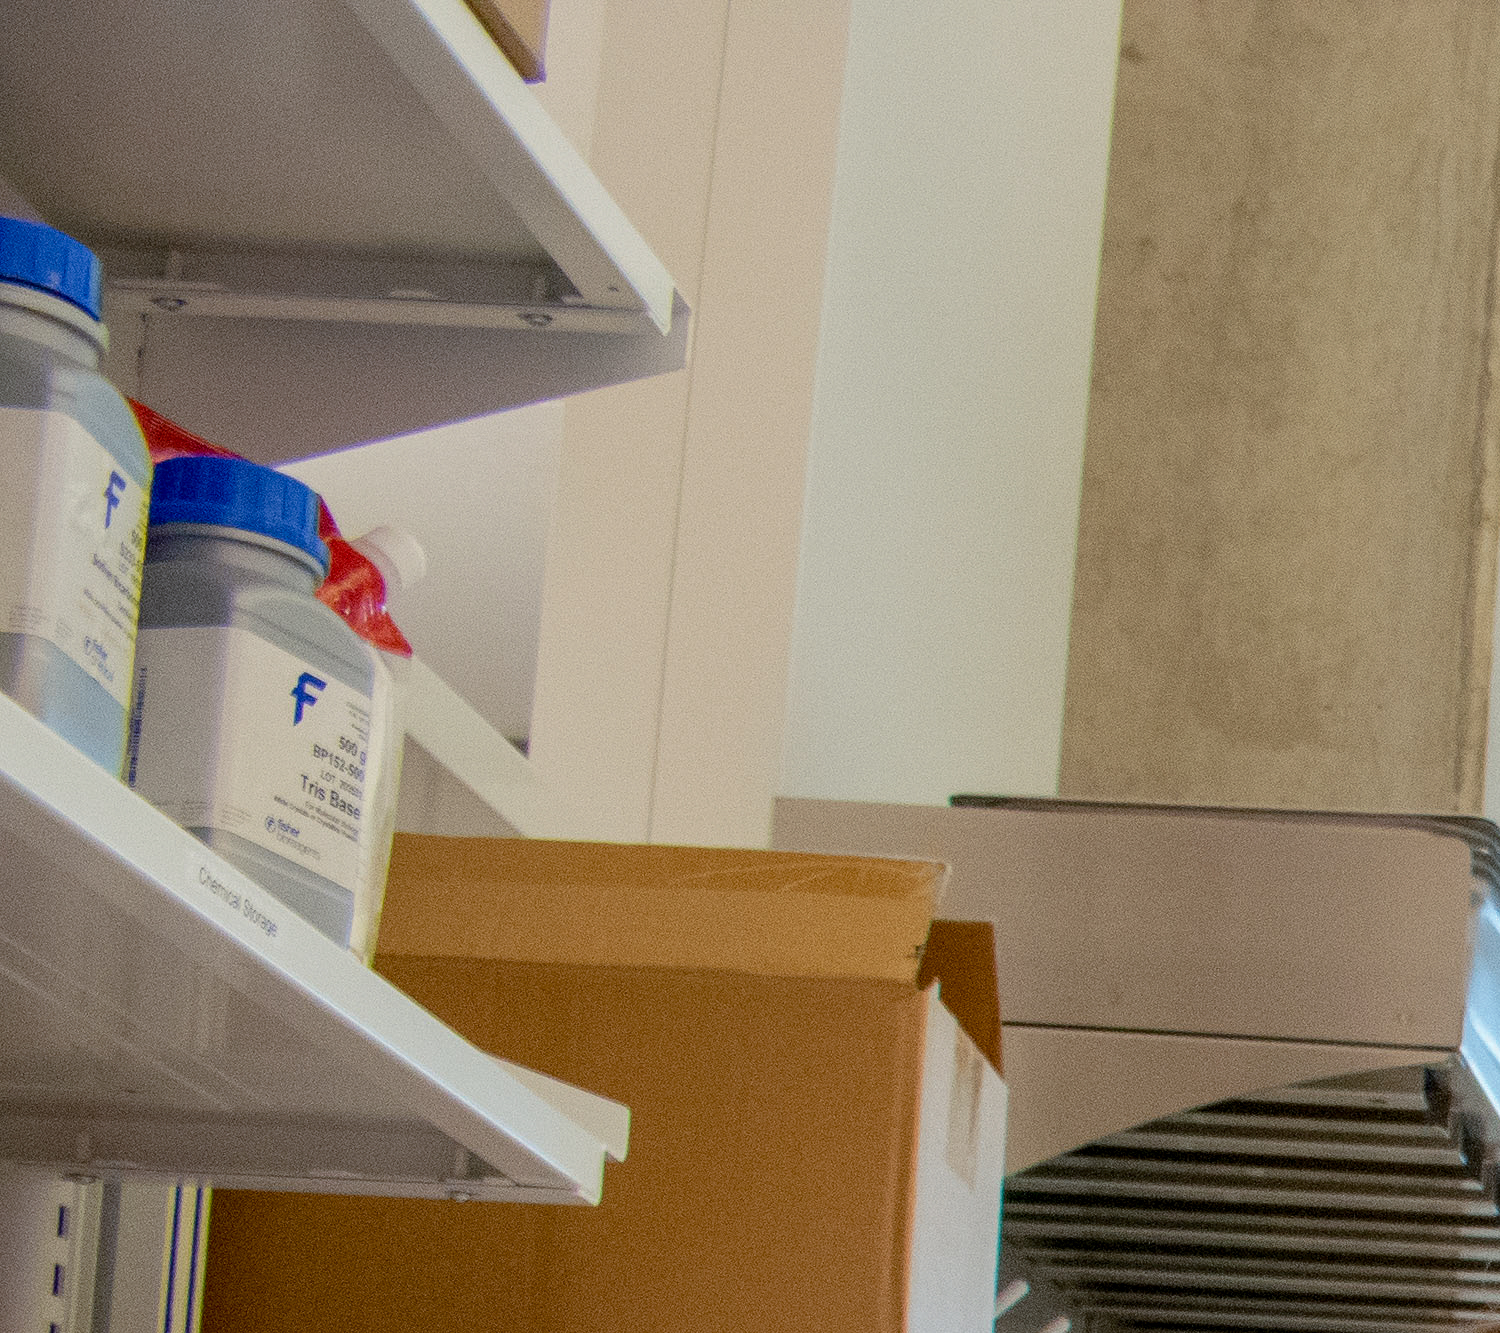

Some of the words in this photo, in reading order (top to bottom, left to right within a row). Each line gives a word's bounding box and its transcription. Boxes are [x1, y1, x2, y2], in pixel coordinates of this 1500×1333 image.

[301, 773, 326, 801] Tris
[329, 790, 361, 820] Base
[199, 865, 242, 909] Chemical
[243, 898, 279, 939] Storage
